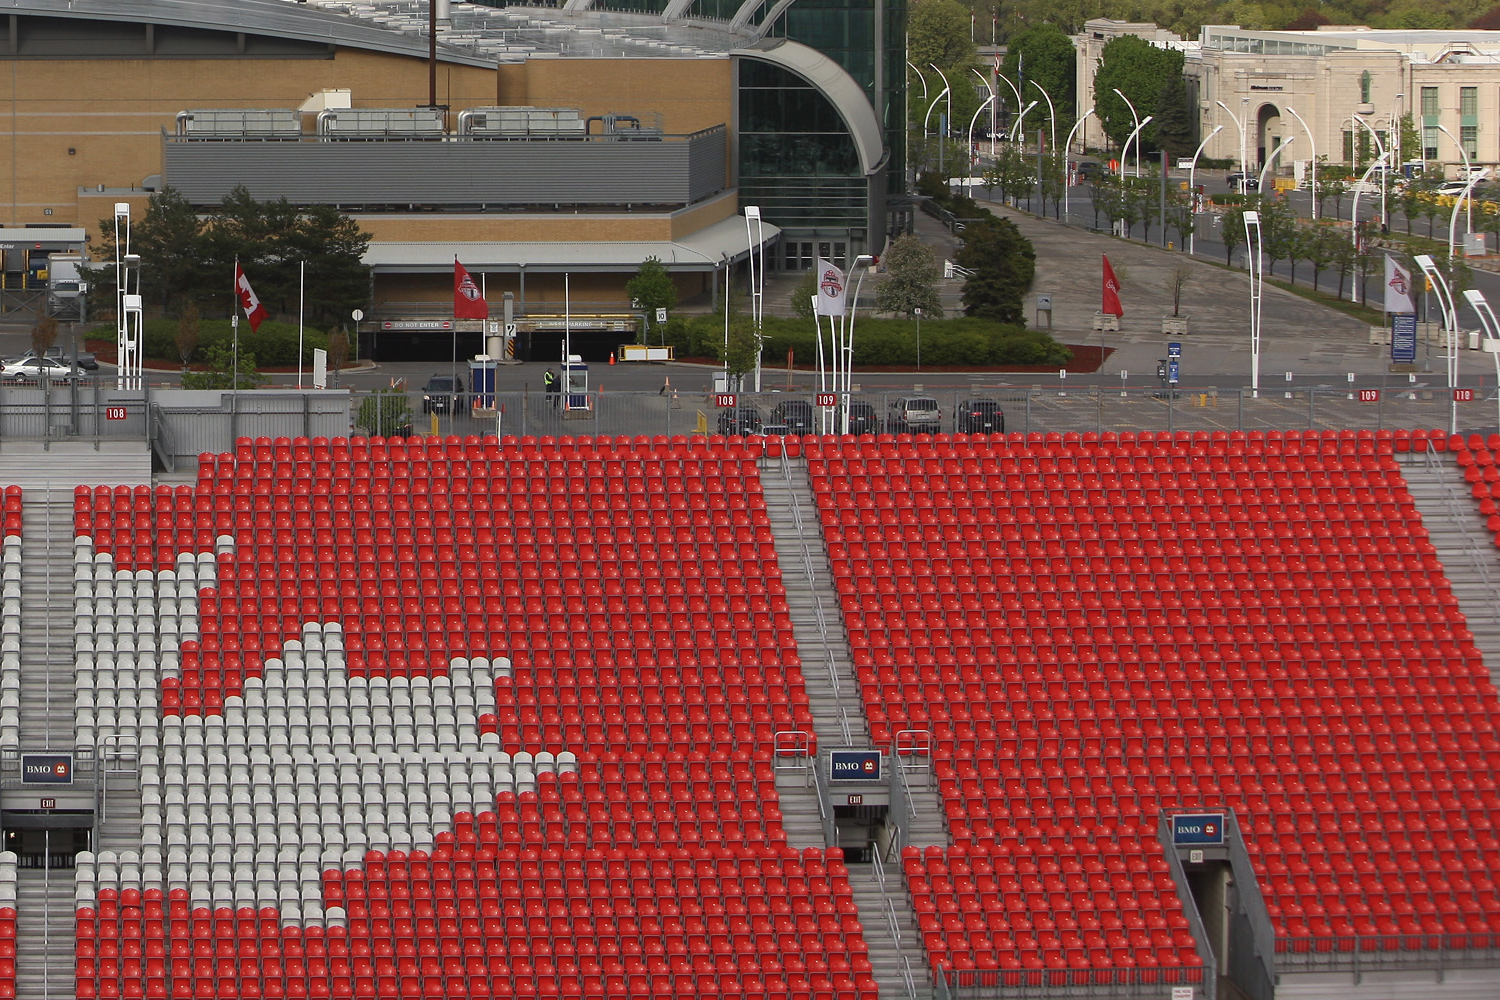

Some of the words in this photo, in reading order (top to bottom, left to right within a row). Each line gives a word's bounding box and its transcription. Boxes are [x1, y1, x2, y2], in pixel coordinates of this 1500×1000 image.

[718, 396, 733, 406] 108
[819, 395, 834, 405] 109
[1361, 391, 1376, 401] 109
[109, 409, 124, 419] 108
[27, 765, 50, 773] BMO
[835, 762, 859, 770] BMO
[1177, 826, 1200, 834] BMO
